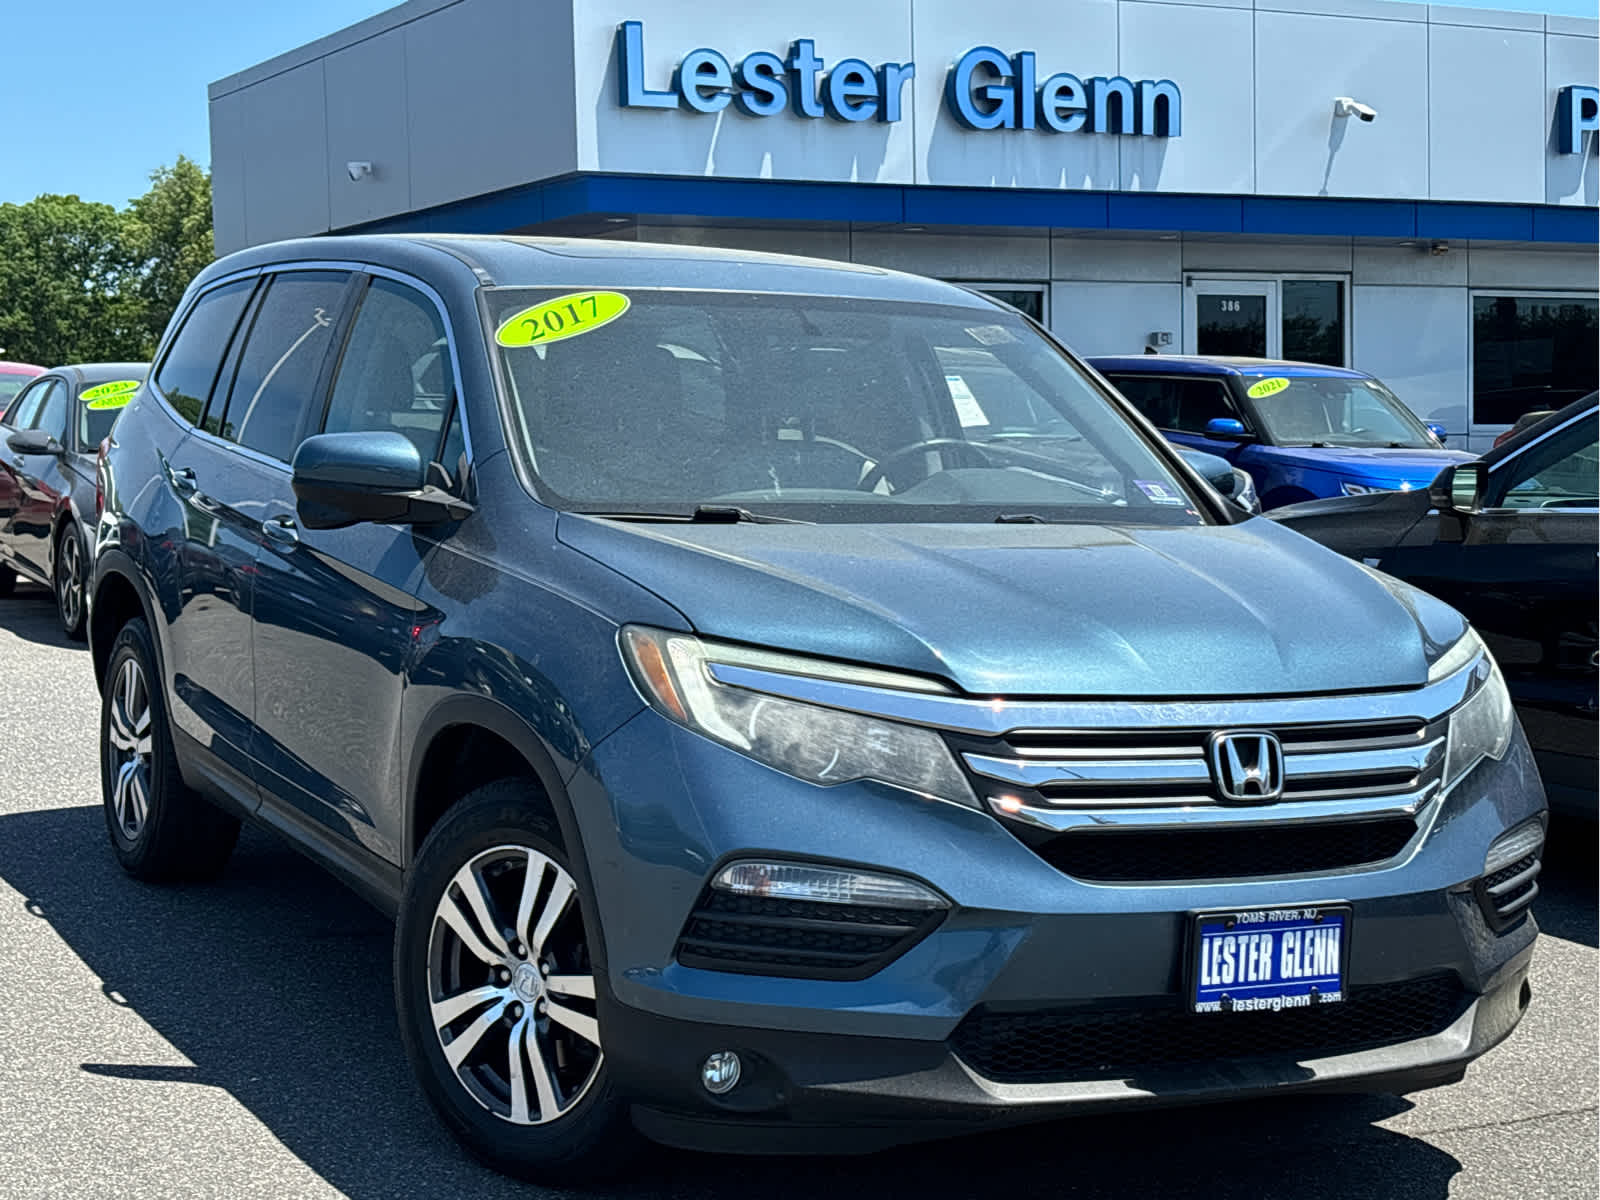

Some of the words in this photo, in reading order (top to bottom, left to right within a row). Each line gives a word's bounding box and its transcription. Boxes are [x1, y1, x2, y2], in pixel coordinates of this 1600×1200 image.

[617, 20, 915, 123] Lester
[947, 45, 1182, 138] Glenn
[1221, 300, 1240, 311] 386
[521, 295, 598, 341] 2017
[1255, 379, 1282, 395] 2021
[1235, 912, 1266, 924] TOMS
[1304, 908, 1318, 919] NJ
[1200, 933, 1273, 986] LESTER
[1280, 927, 1341, 979] GLENN
[1231, 994, 1311, 1012] lesterglenn
